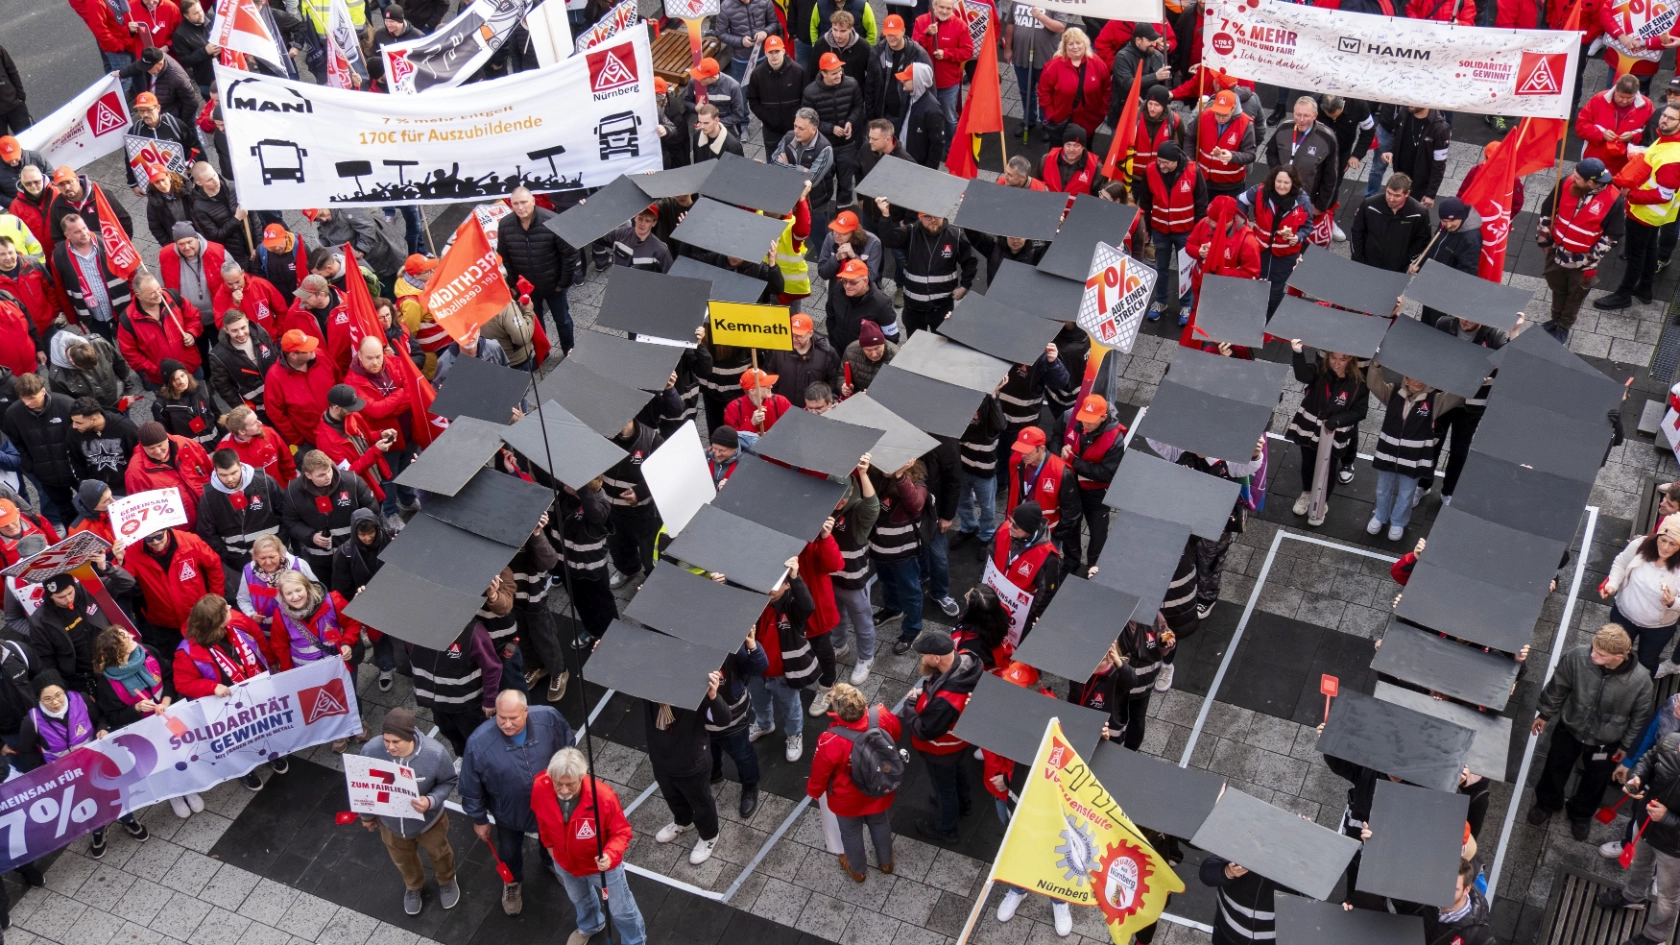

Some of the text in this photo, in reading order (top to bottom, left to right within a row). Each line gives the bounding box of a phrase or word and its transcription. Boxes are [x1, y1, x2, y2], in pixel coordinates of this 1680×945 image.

[970, 15, 987, 30] EINEN
[1638, 9, 1675, 35] AUF EINEN
[1250, 25, 1298, 46] MEHR
[1236, 36, 1257, 49] NÖTIG
[1260, 43, 1274, 52] UND
[1276, 47, 1296, 56] FAIR!
[1367, 43, 1431, 60] HAMM
[1239, 48, 1257, 60] Ich
[1258, 55, 1275, 66] bin
[1458, 60, 1513, 72] SOLIDARITÄT
[1472, 69, 1511, 81] GEWINNT
[593, 83, 640, 102] Nürnberg
[234, 97, 304, 113] MAN
[359, 115, 543, 145] 170€ für Auszubildende
[166, 154, 181, 172] EINEN
[1111, 283, 1148, 316] AUF EINEN
[1113, 298, 1145, 326] STREICH
[714, 318, 788, 335] Kemnath
[120, 498, 169, 517] GEMEINSAM
[121, 512, 136, 522] FÜR
[169, 694, 290, 750] SOLIDARITÄT
[210, 709, 294, 753] GEWINNT
[215, 753, 226, 761] MIT
[227, 743, 247, 756] FRAUEN
[254, 734, 265, 743] DER
[272, 724, 295, 735] METALL
[57, 767, 84, 785] FÜR
[351, 781, 417, 798] ZUM FAIRLIEBEN
[1110, 867, 1136, 888] Nürnberg
[1114, 858, 1137, 878] Qualität
[1036, 879, 1089, 902] Nürnberg
